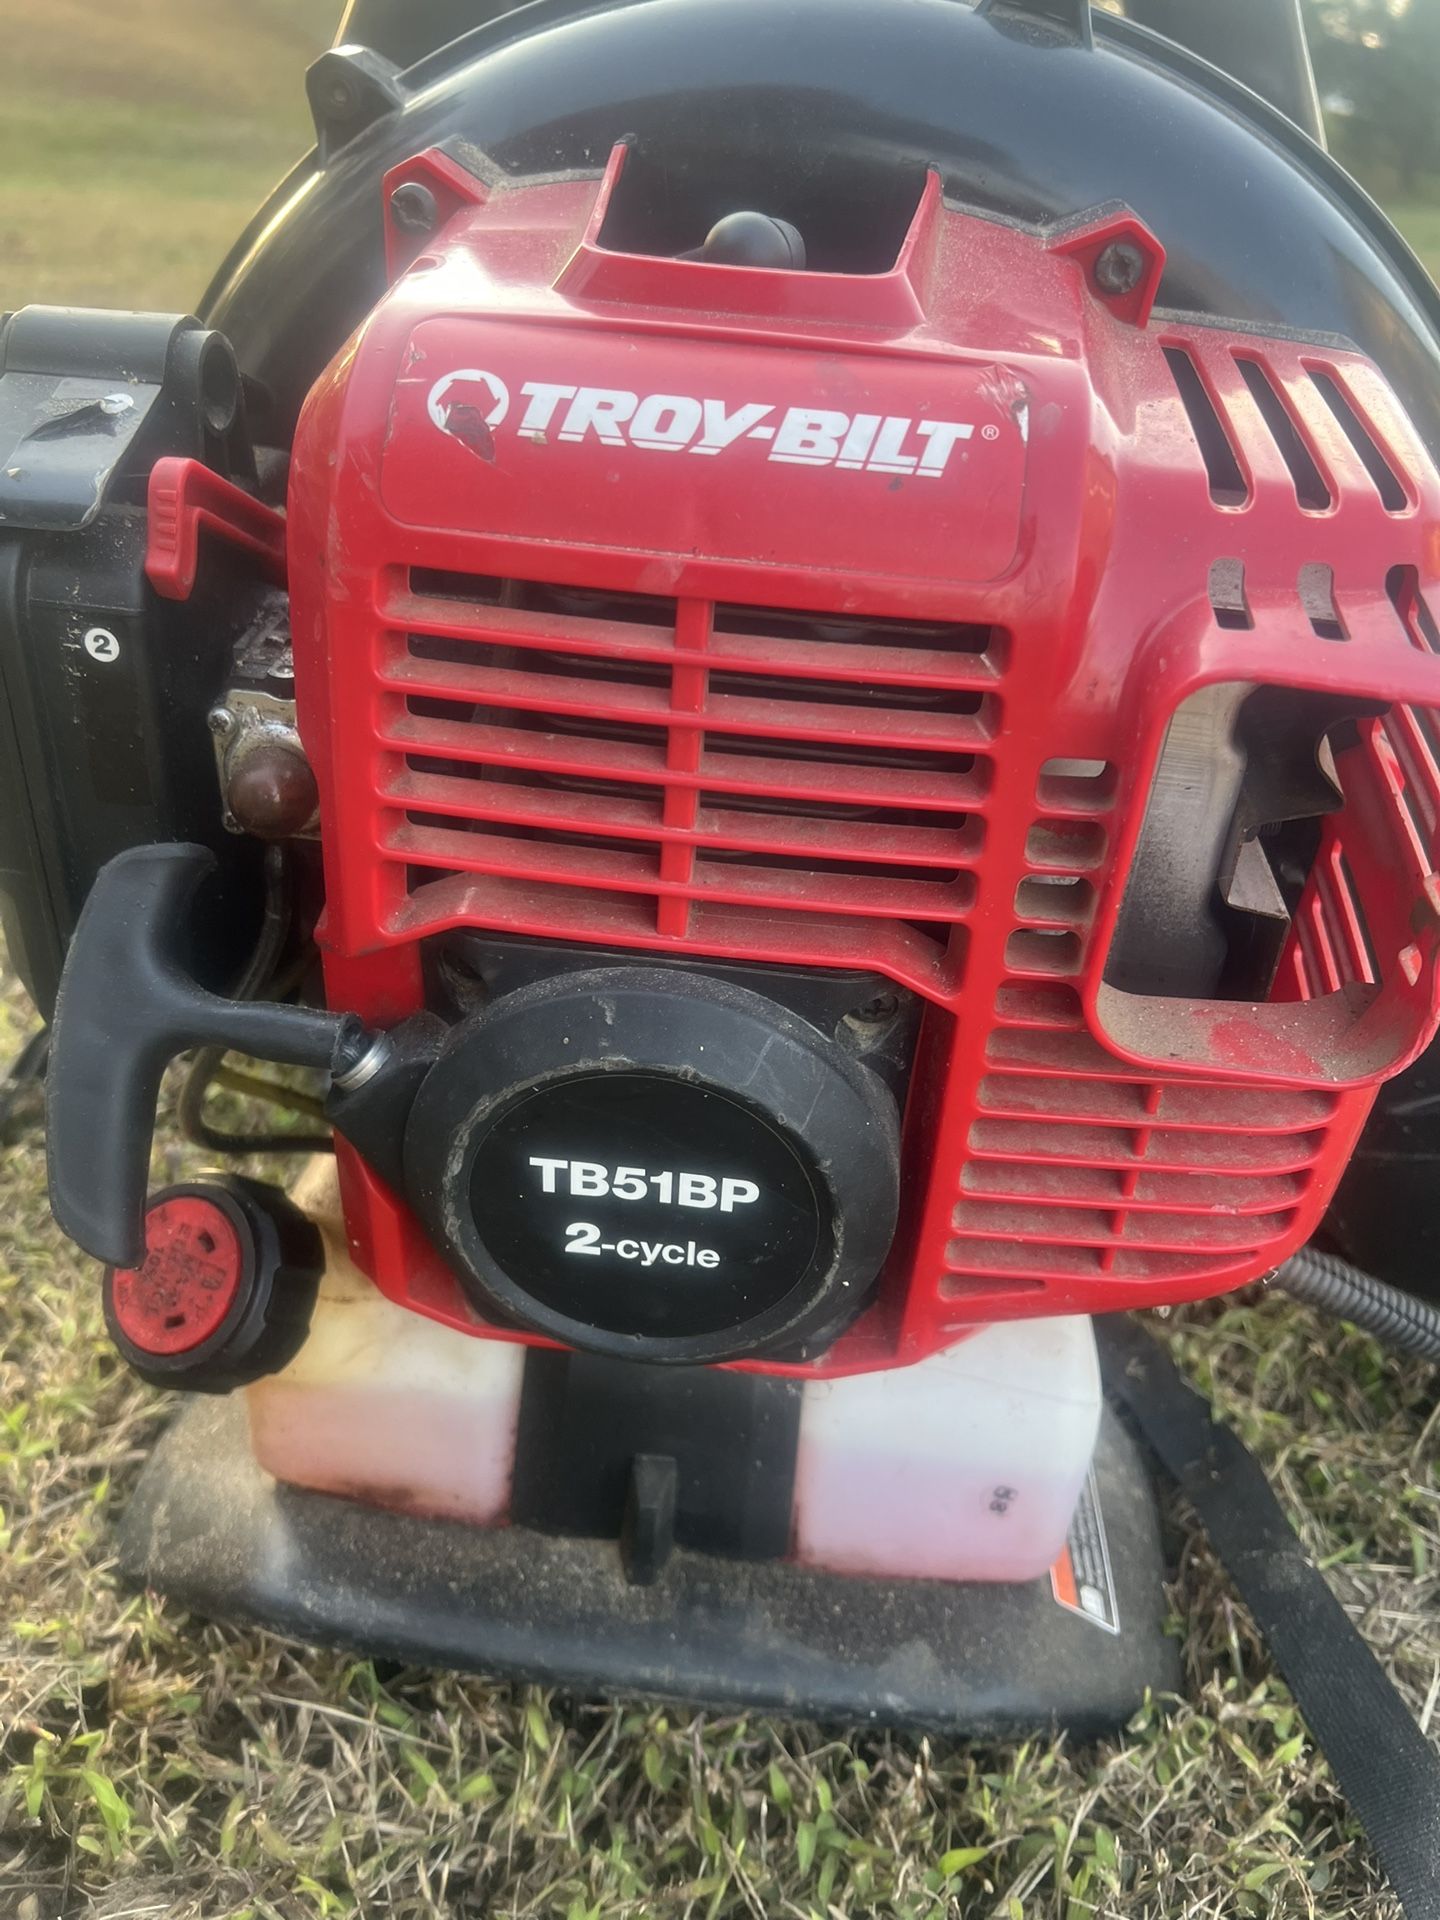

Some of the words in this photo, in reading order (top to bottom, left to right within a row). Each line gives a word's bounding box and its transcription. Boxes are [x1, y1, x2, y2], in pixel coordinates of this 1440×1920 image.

[516, 382, 975, 478] TROY-BILT
[92, 634, 113, 656] 2
[529, 1156, 761, 1213] TB51BP
[564, 1222, 721, 1269] 2-cycle
